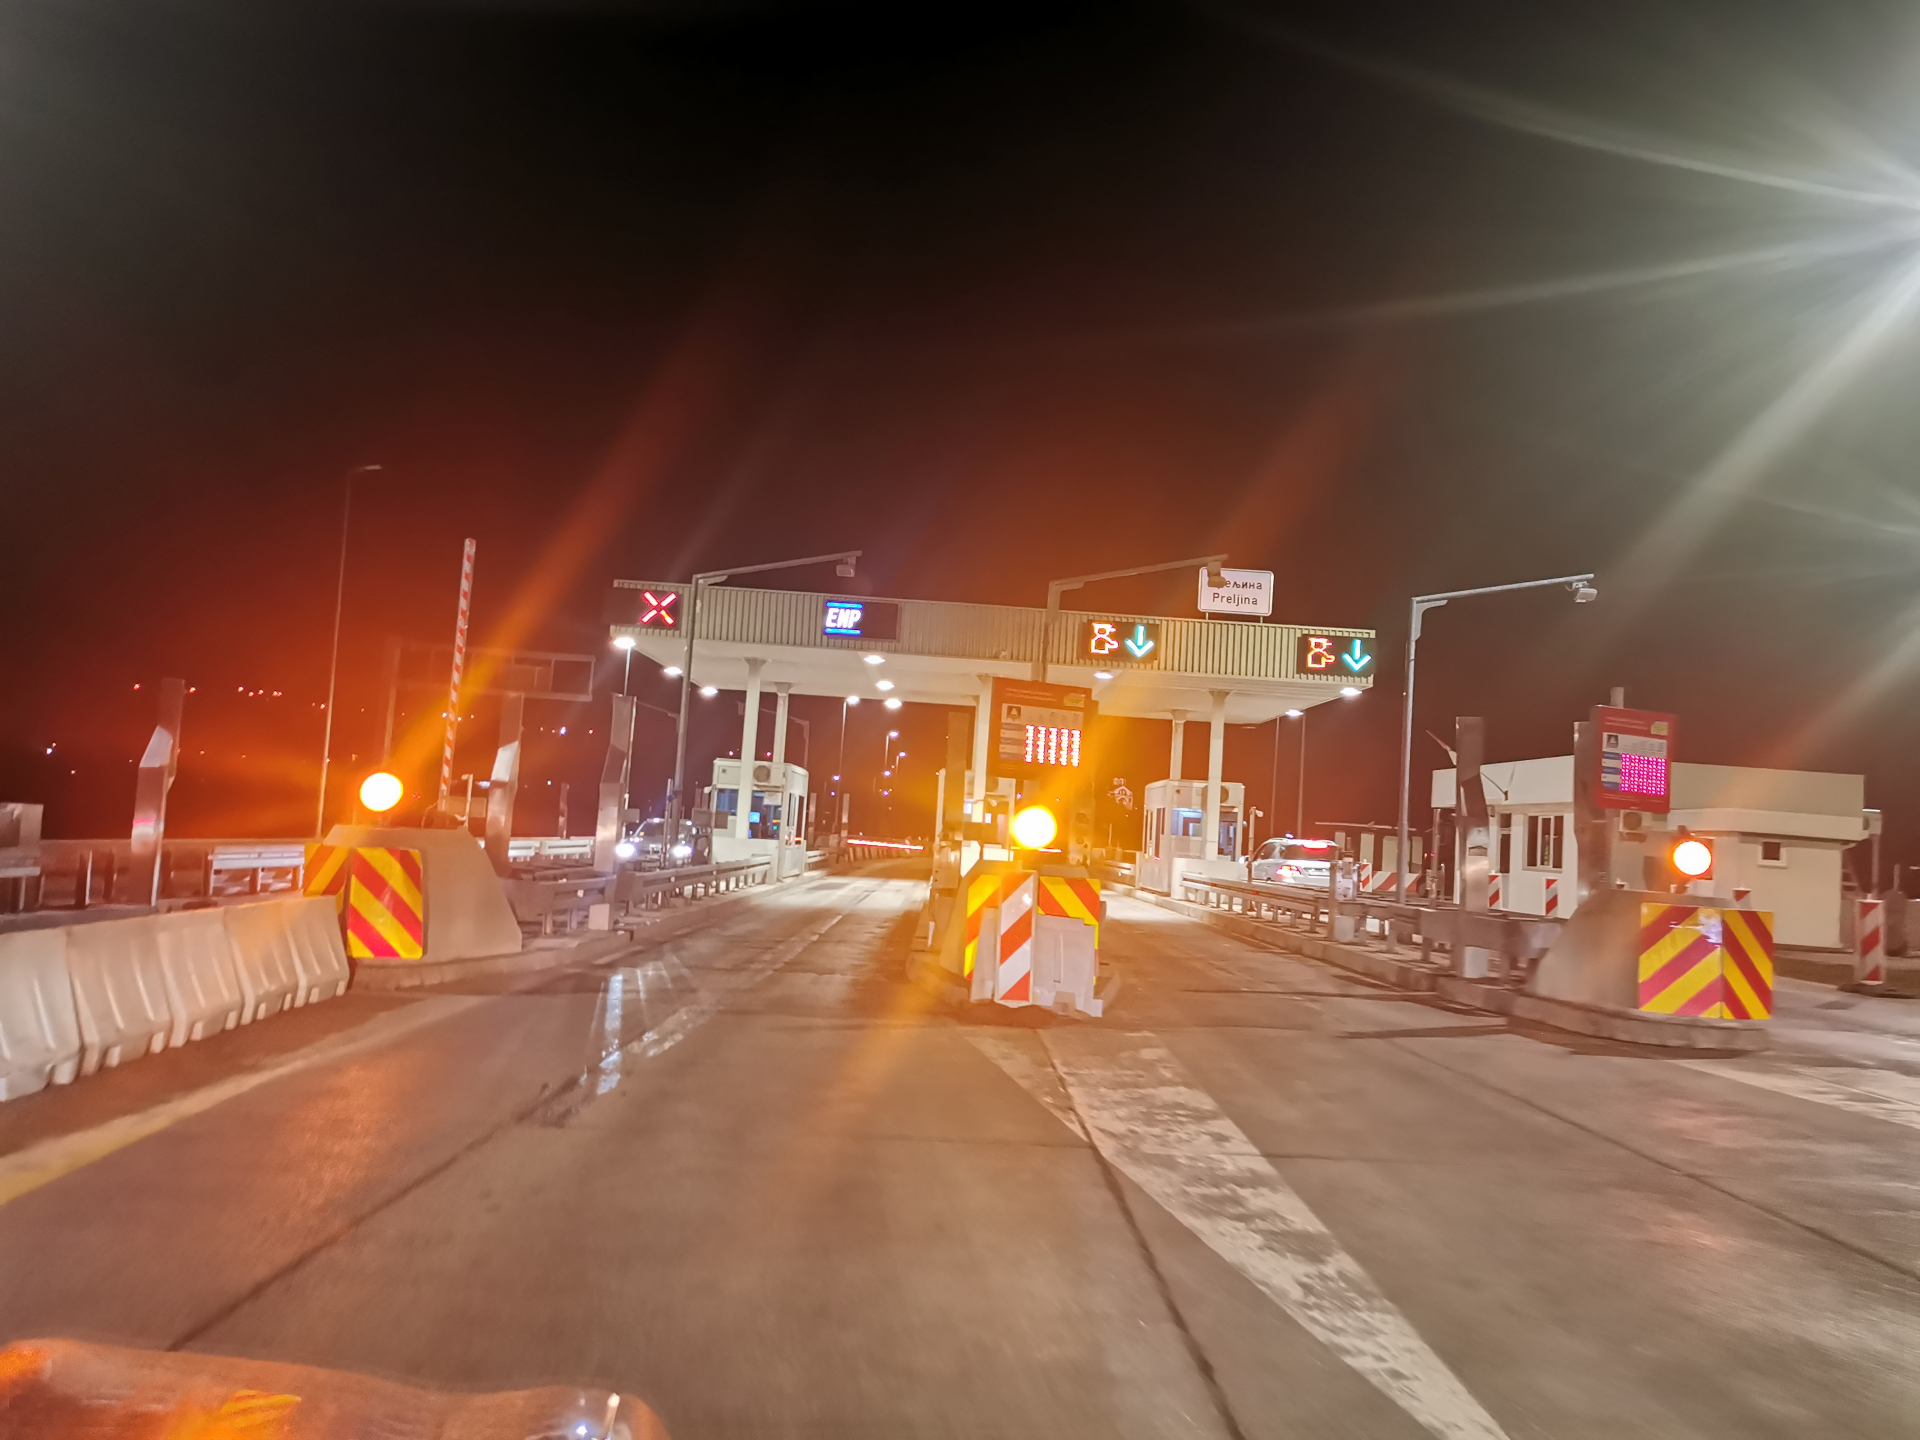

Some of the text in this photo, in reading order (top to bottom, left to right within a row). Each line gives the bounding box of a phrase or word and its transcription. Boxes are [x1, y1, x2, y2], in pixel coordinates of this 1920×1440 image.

[1225, 580, 1262, 590] ељина
[1212, 592, 1258, 606] Preljina
[825, 607, 861, 629] ENP
